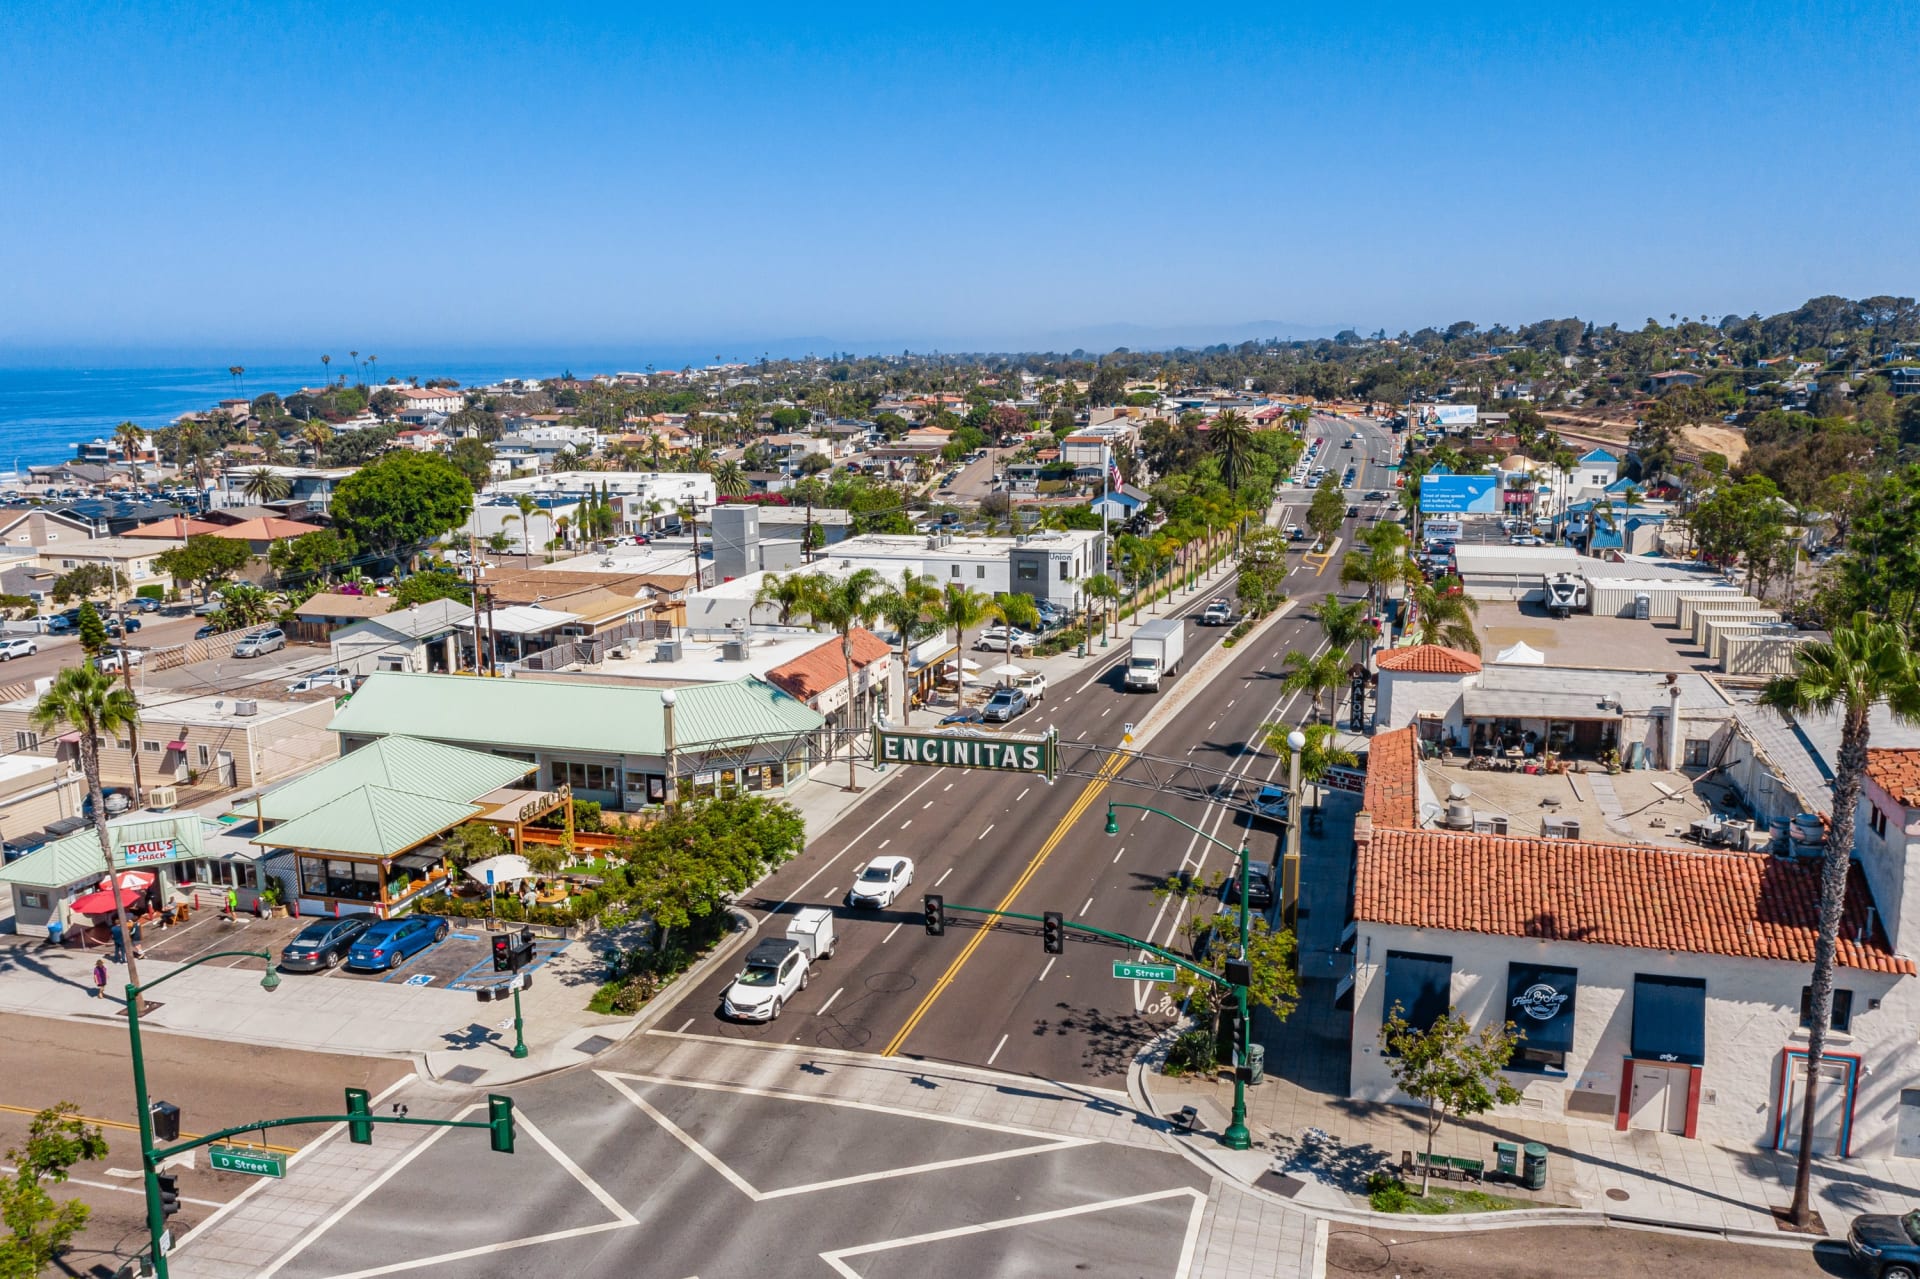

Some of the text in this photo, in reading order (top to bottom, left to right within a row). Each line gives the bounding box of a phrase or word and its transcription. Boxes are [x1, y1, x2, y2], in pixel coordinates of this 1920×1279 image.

[1050, 552, 1072, 561] Union
[1353, 680, 1362, 728] PALOMA
[884, 737, 1039, 769] ENCINITAS
[519, 791, 556, 822] GELATO
[127, 840, 173, 855] RAUL'S
[137, 852, 167, 862] SHACK
[1123, 968, 1165, 978] D Street
[221, 1157, 268, 1172] D Street
